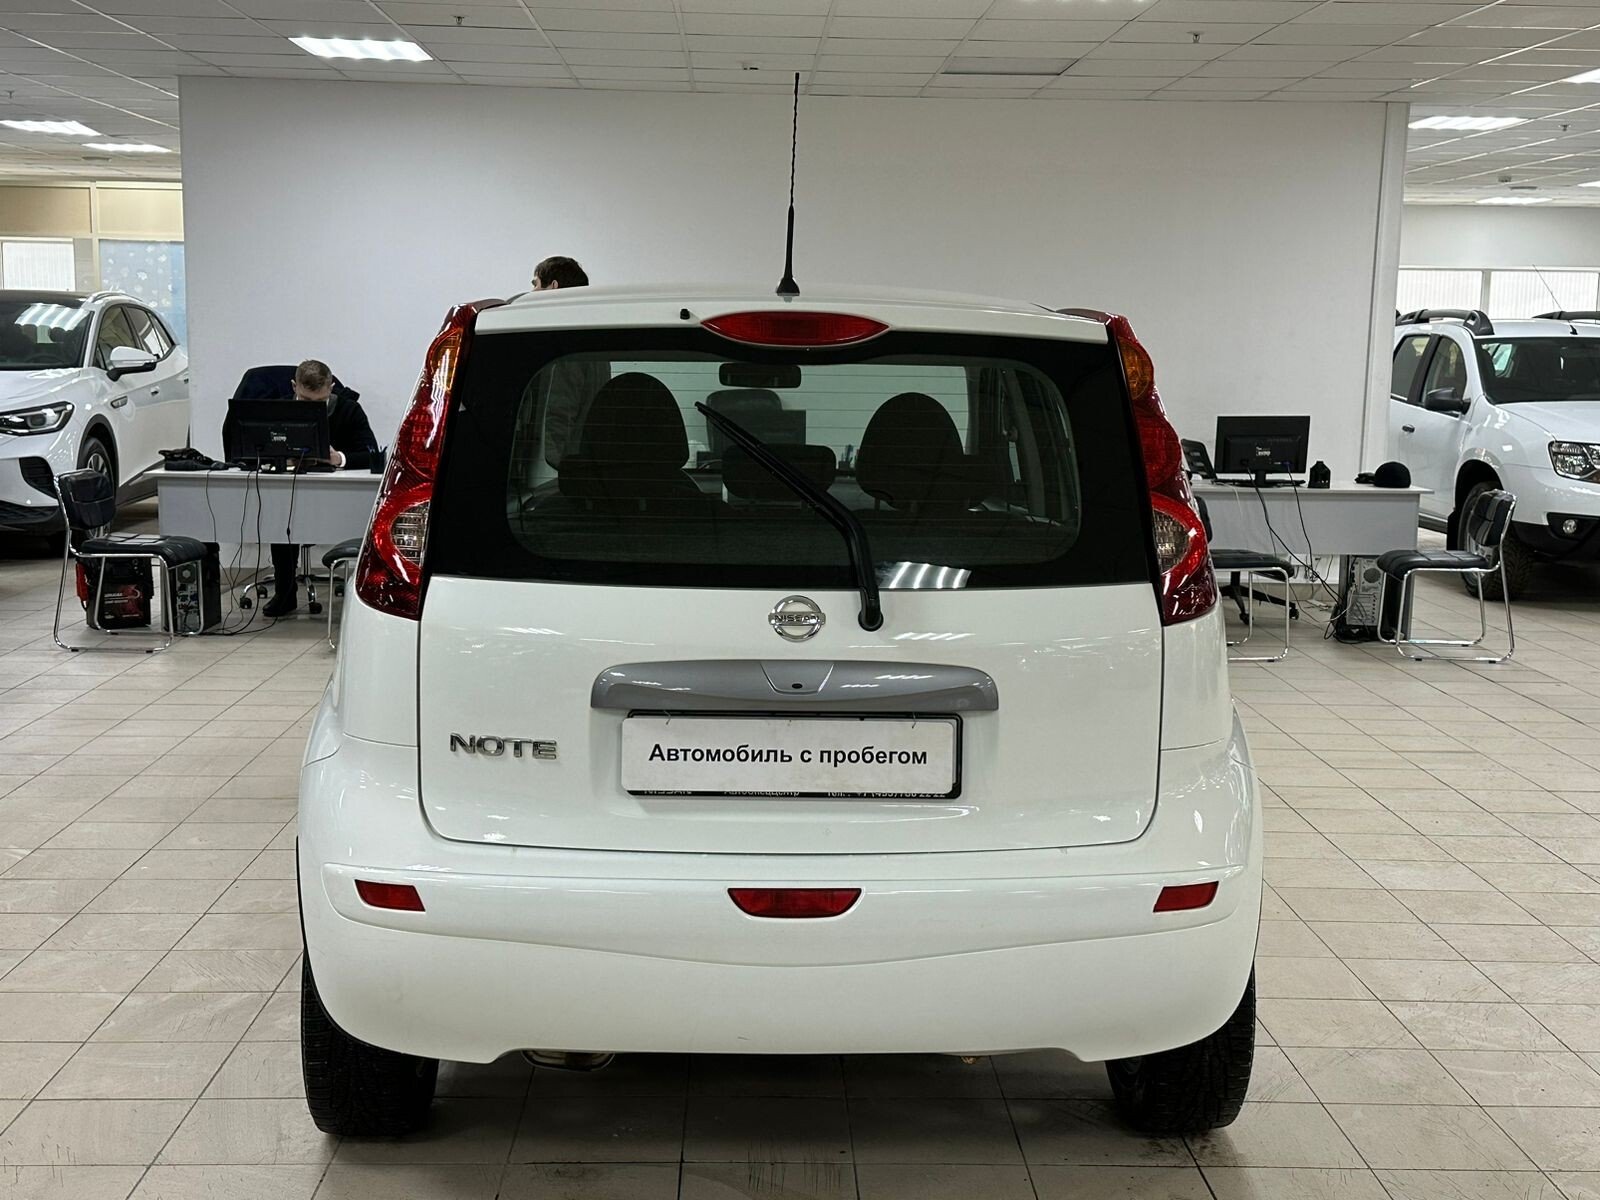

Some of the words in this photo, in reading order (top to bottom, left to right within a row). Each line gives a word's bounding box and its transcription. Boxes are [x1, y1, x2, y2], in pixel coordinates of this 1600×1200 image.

[774, 614, 820, 623] NISSAN
[450, 732, 557, 760] NOTE
[649, 743, 793, 763] Автомобиль
[800, 748, 812, 763] с
[819, 746, 928, 768] пробегом
